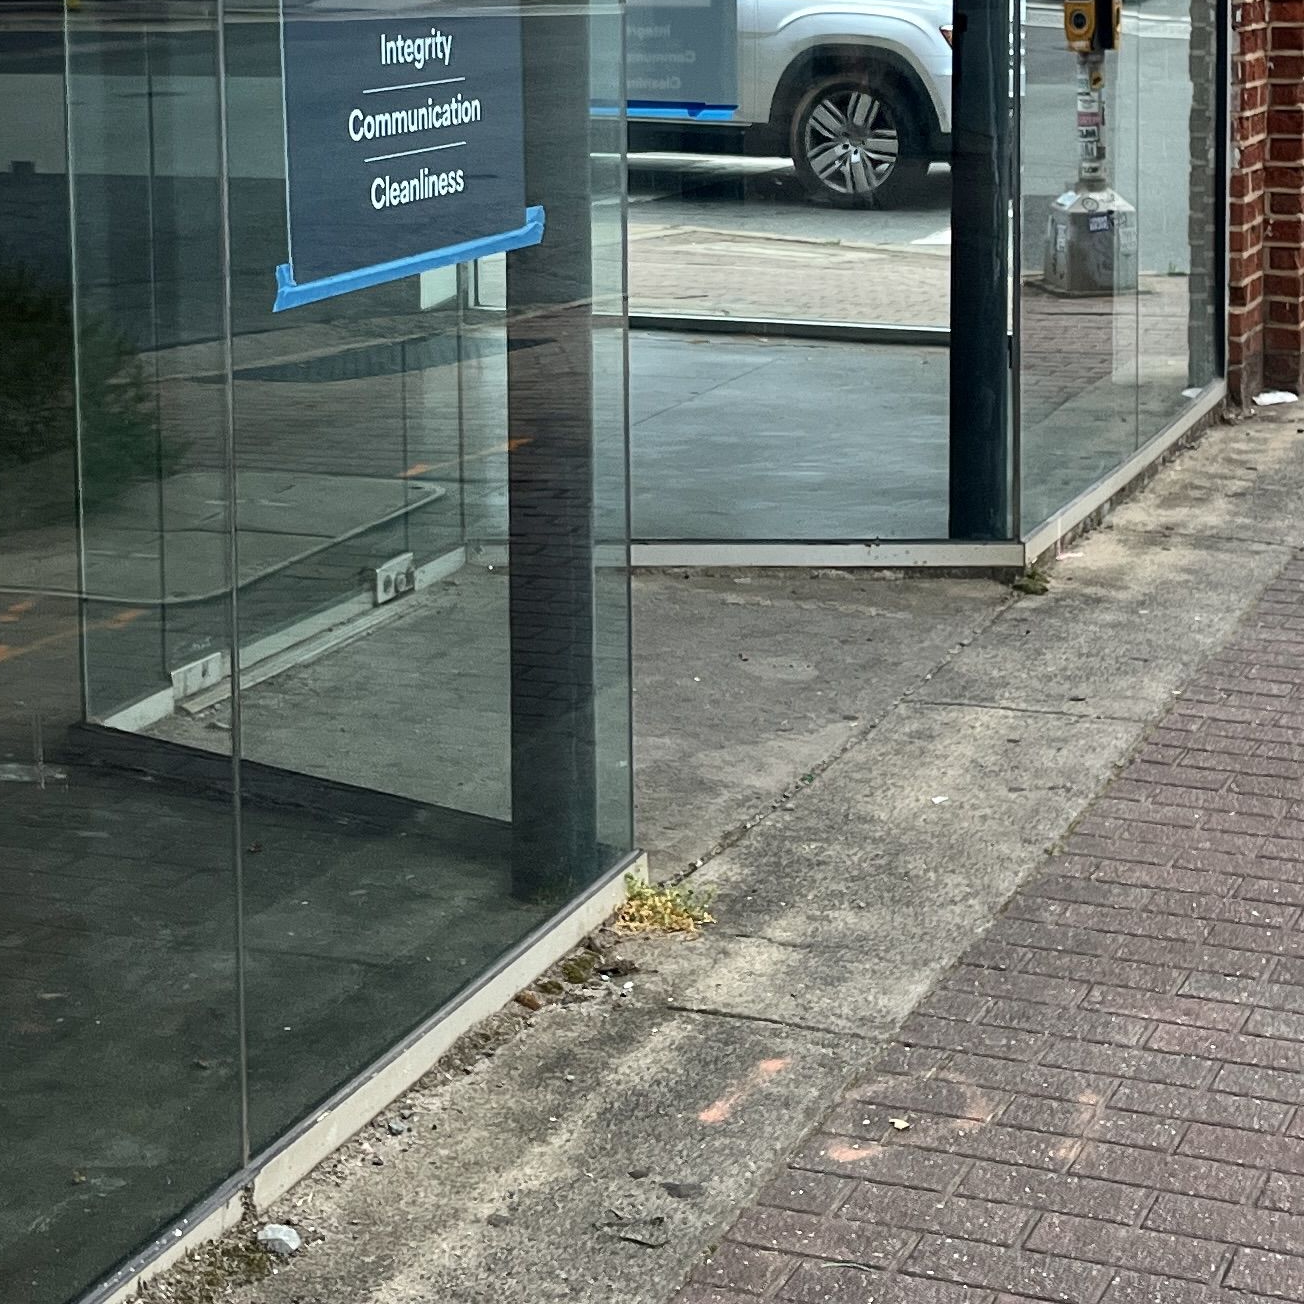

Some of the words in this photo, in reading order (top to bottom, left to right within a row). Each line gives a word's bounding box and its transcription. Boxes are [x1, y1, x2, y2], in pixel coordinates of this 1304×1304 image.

[380, 29, 453, 70] Integrity
[348, 93, 481, 143] Communication
[369, 162, 465, 210] Cleanliness
